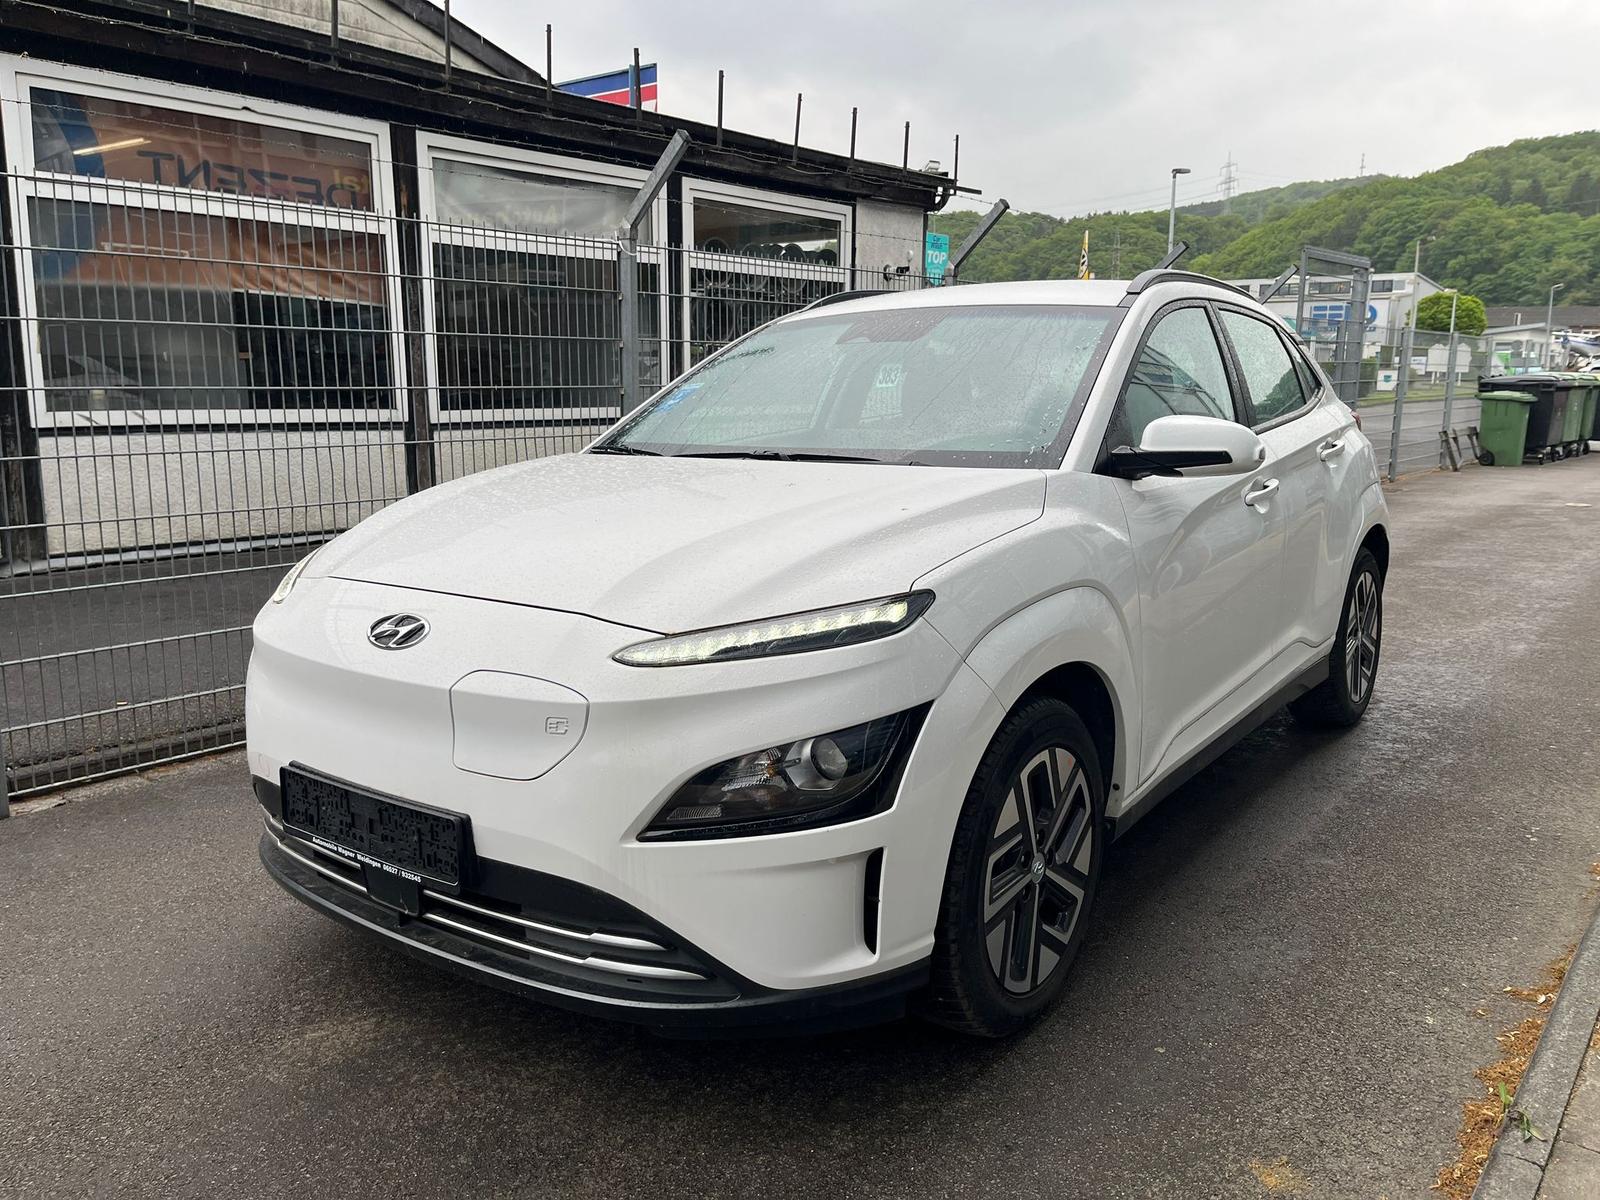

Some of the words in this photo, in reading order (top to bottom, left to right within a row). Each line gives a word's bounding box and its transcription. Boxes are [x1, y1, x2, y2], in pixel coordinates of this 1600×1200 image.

[927, 250, 946, 264] TOP
[312, 837, 337, 851] Automobile
[338, 846, 355, 857] Wagner
